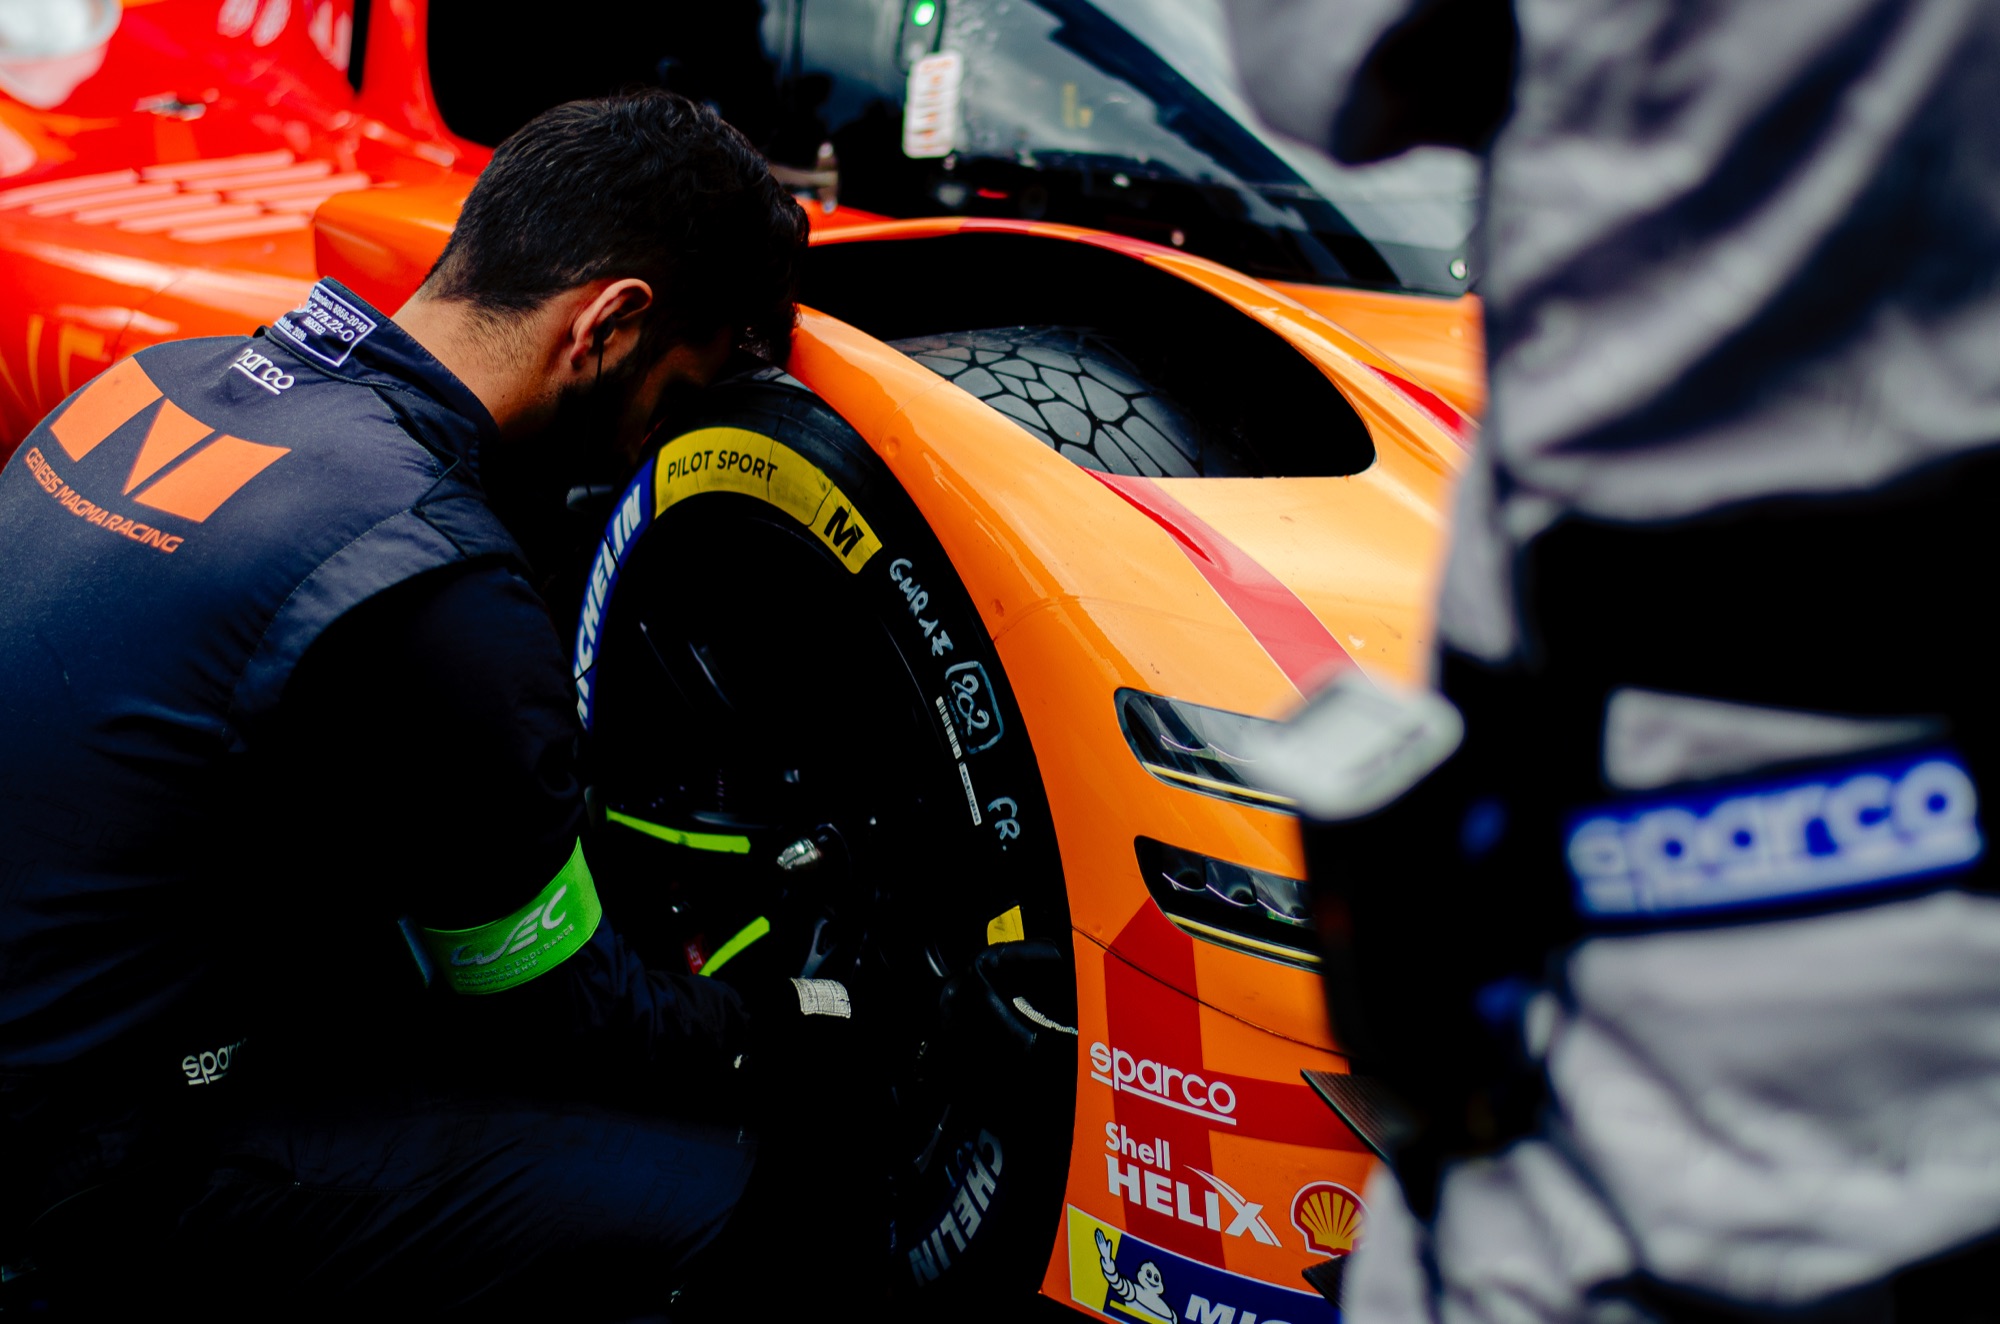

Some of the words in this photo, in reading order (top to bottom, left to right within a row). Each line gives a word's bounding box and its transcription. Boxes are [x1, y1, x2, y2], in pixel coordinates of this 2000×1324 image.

[229, 348, 295, 396] parco
[25, 447, 64, 494] GENESIS
[54, 485, 110, 526] MAGMA
[104, 513, 185, 553] RACING
[667, 450, 714, 484] PILOT
[716, 449, 779, 483] SPORT
[823, 505, 865, 558] M
[1568, 760, 1983, 915] sparco
[1089, 1041, 1237, 1125] sparco
[1105, 1121, 1171, 1172] Shell
[908, 1128, 1003, 1288] CHELIN
[1104, 1153, 1283, 1248] HELIX
